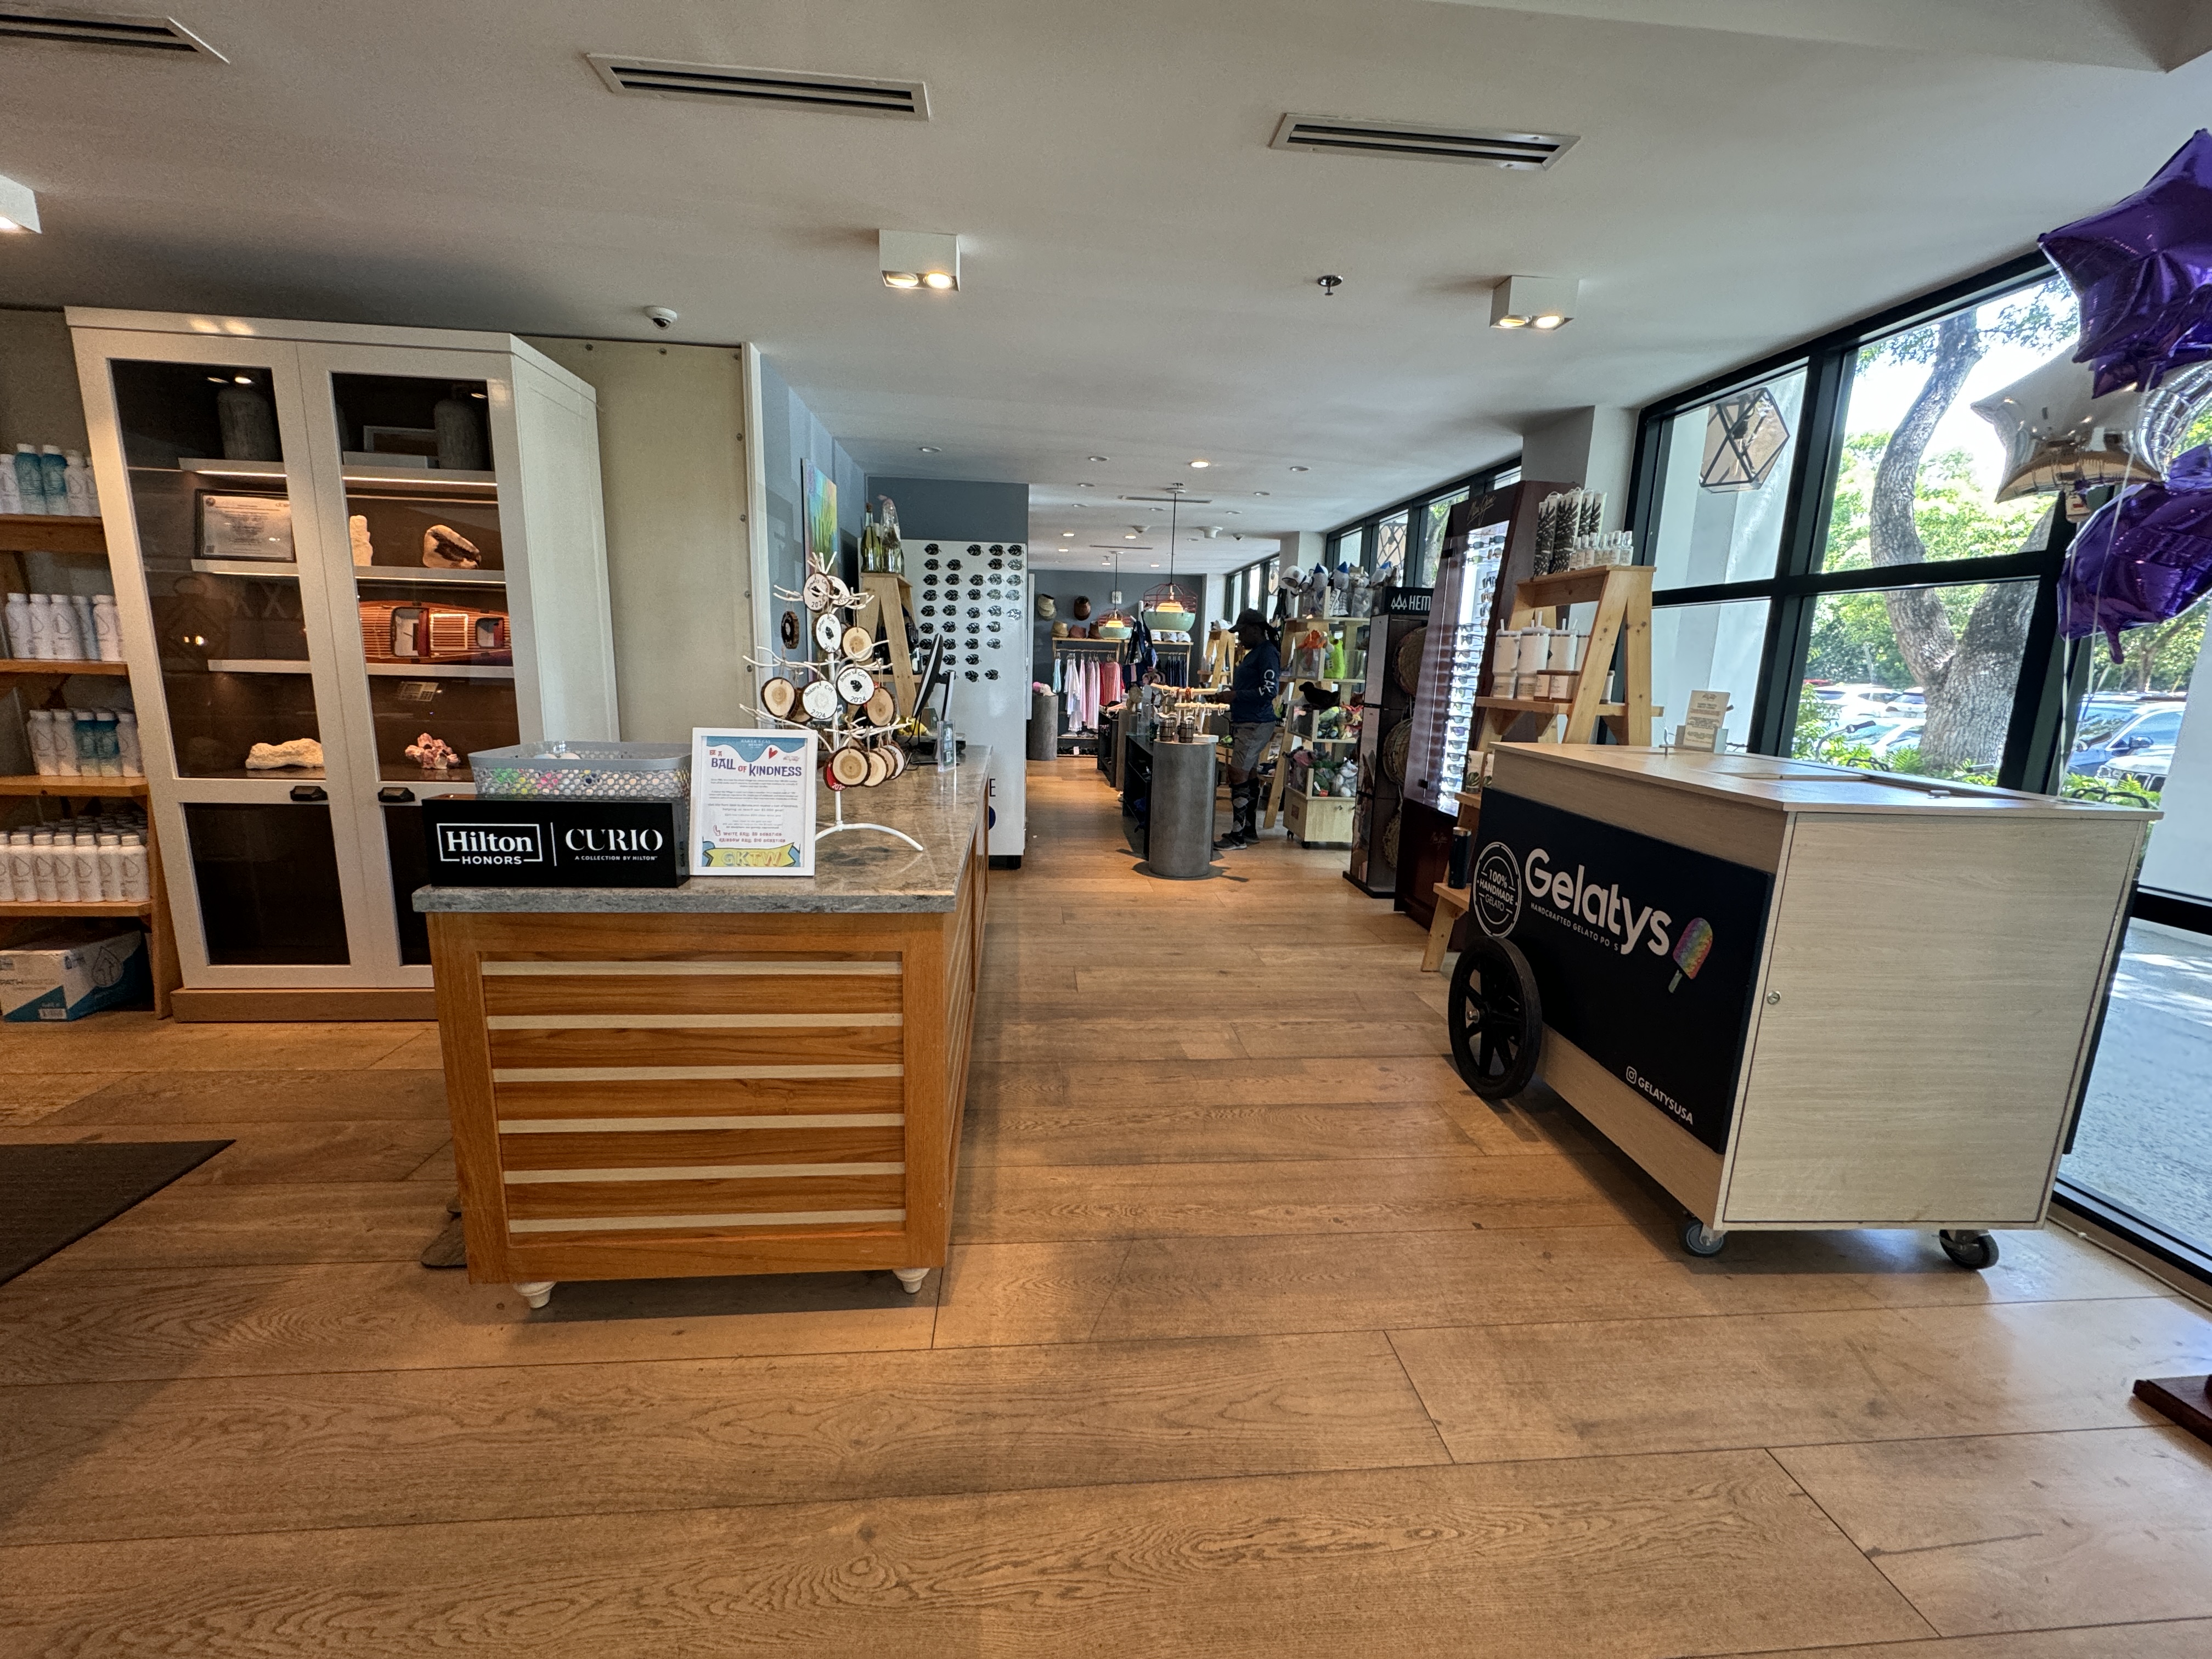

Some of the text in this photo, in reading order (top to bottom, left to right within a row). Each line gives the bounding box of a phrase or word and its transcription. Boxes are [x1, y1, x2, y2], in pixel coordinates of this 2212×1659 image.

[711, 757, 736, 770] BALL
[749, 763, 802, 777] KINDNESS
[446, 831, 533, 852] Hilton
[565, 828, 663, 851] CURIO
[462, 856, 522, 865] HONORS
[722, 851, 781, 866] GKTW
[1489, 868, 1508, 889] 100%
[1479, 878, 1514, 905] HANDMADE
[1525, 848, 1672, 956] Gelatys
[1485, 894, 1505, 912] GELATO
[1531, 902, 1571, 927] HANDCRAFTED
[1572, 923, 1599, 941] GELATO
[1638, 1076, 1694, 1125] GELATYSUSA
